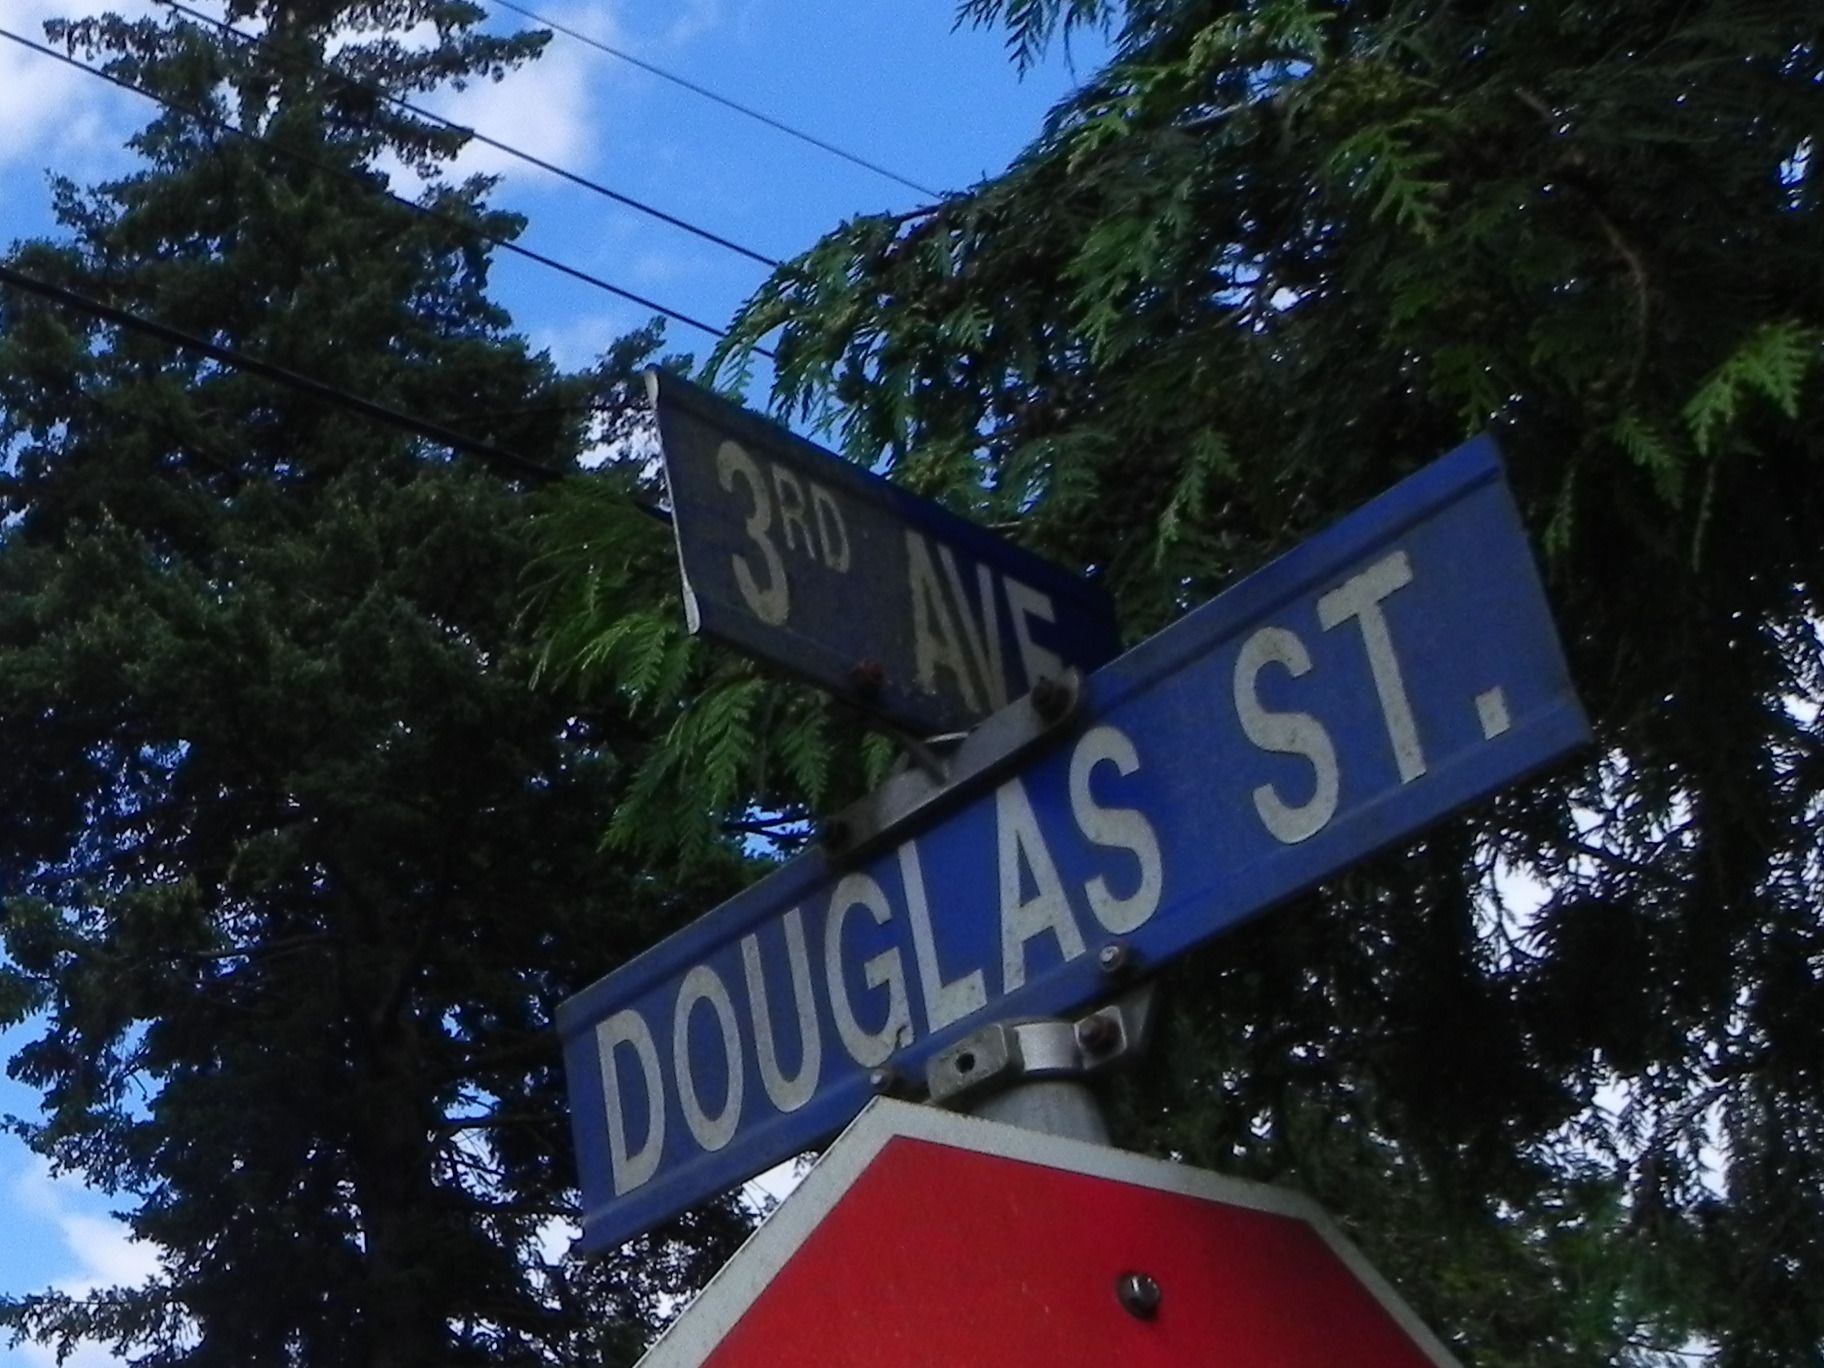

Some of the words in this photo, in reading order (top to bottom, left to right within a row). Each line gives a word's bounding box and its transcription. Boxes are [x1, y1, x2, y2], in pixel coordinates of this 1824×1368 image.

[716, 440, 850, 627] 3RD
[595, 726, 1164, 1197] DOUGLAS
[1232, 550, 1512, 845] ST.
